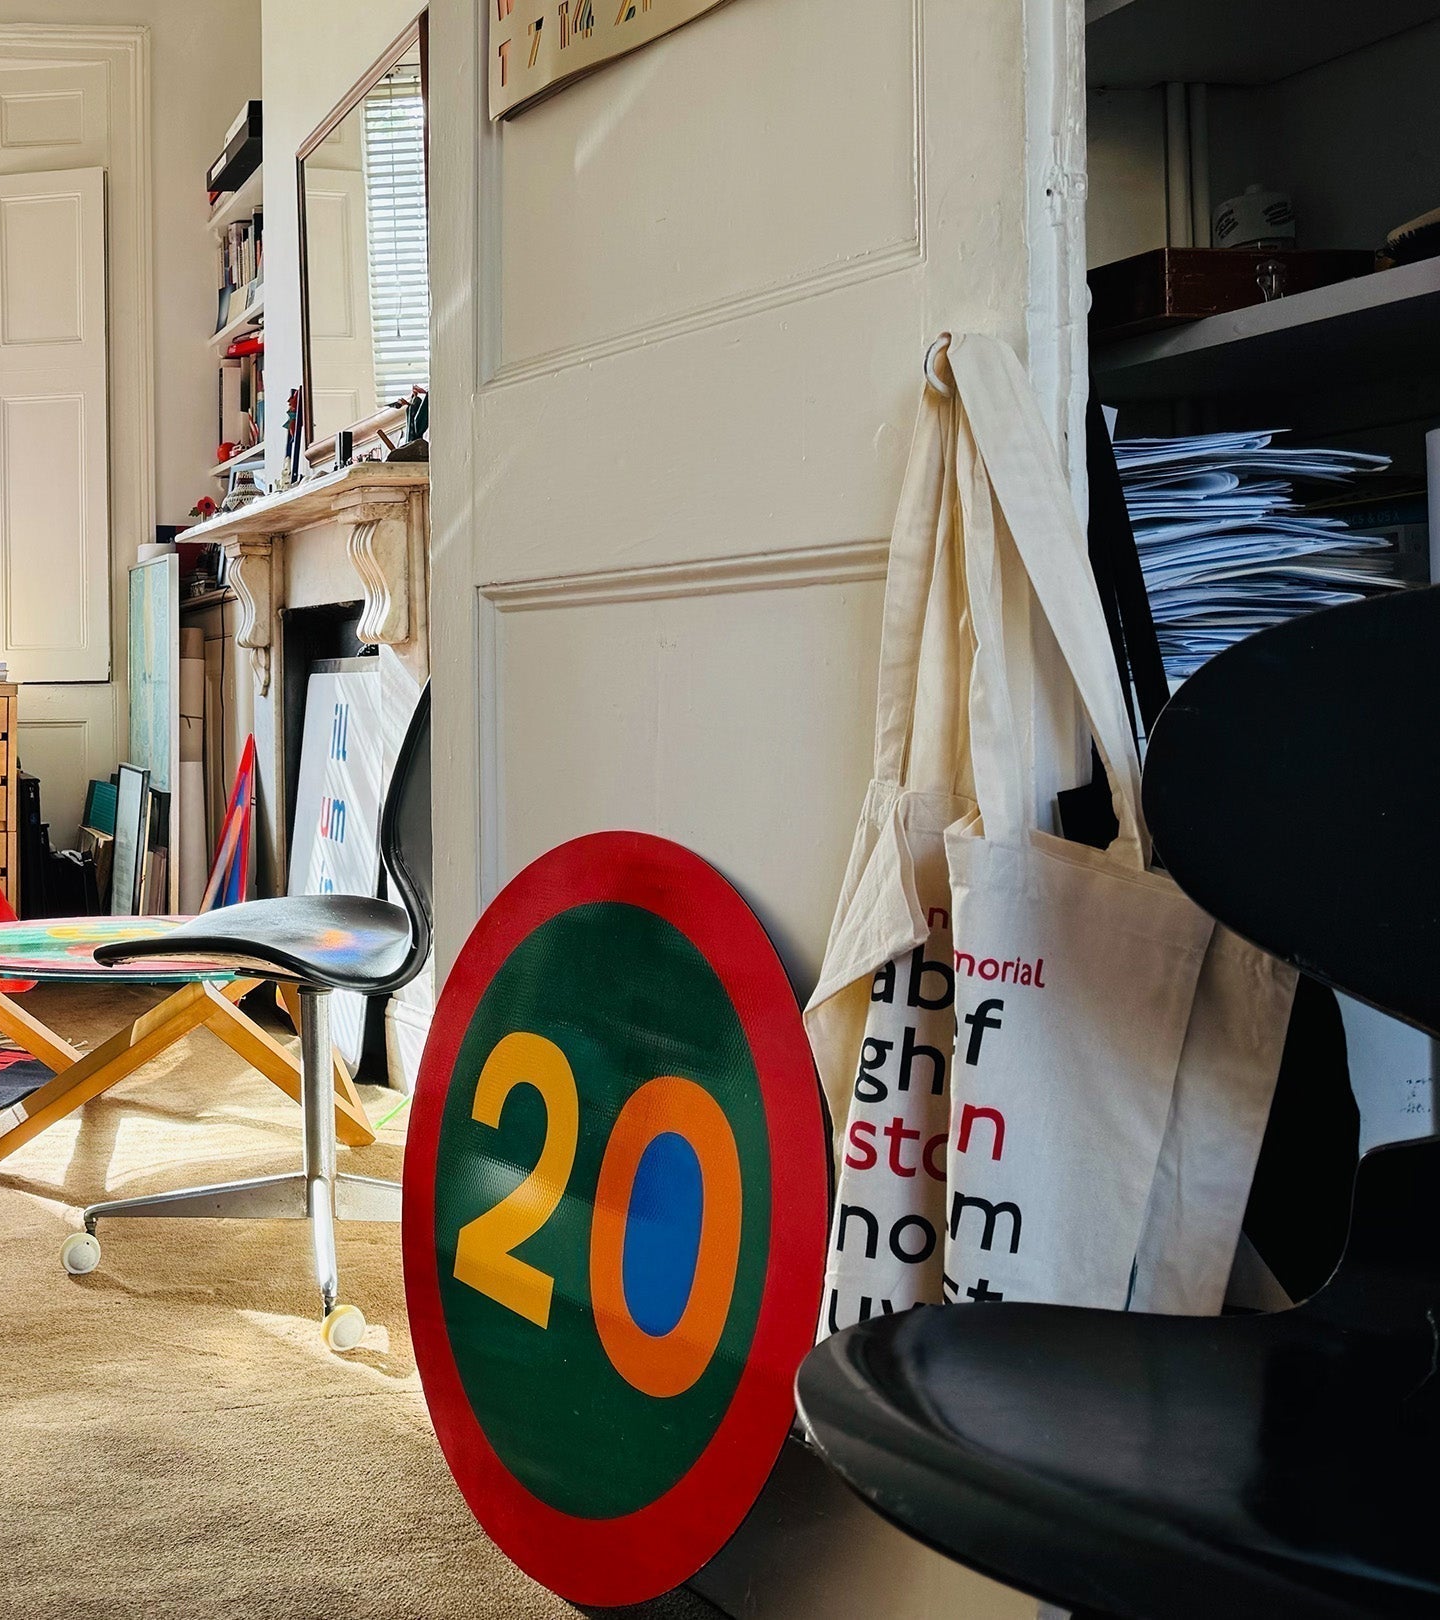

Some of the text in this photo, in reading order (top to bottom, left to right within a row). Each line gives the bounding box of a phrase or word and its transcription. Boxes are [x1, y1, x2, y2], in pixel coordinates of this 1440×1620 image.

[527, 16, 545, 69] 7
[558, 0, 594, 50] 14
[614, 0, 652, 26] 2
[331, 703, 349, 761] ill
[320, 796, 346, 843] um
[854, 1026, 947, 1103] gh
[453, 1031, 743, 1398] 20
[837, 1203, 937, 1264] no
